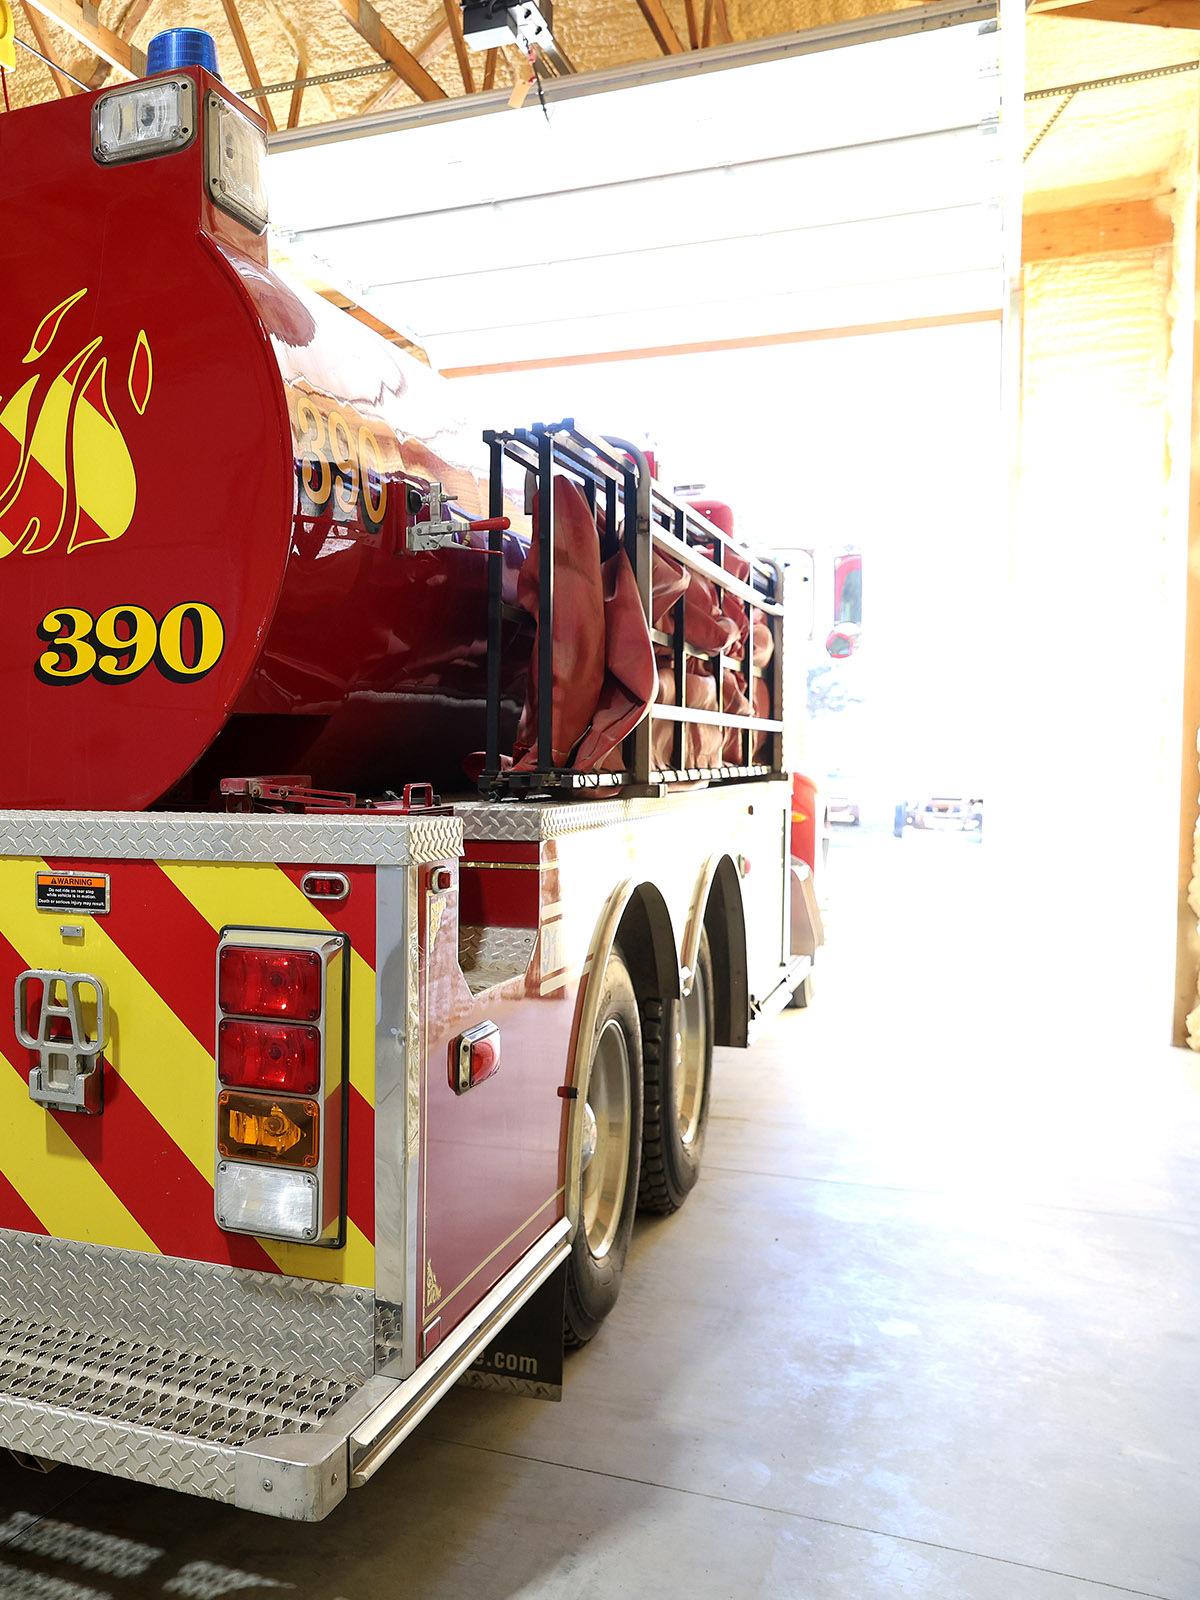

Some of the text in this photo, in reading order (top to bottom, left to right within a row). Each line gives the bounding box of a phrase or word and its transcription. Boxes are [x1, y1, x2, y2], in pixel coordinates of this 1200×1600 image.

[297, 397, 387, 534] 390
[34, 600, 225, 686] 390
[57, 878, 93, 886] WARNING
